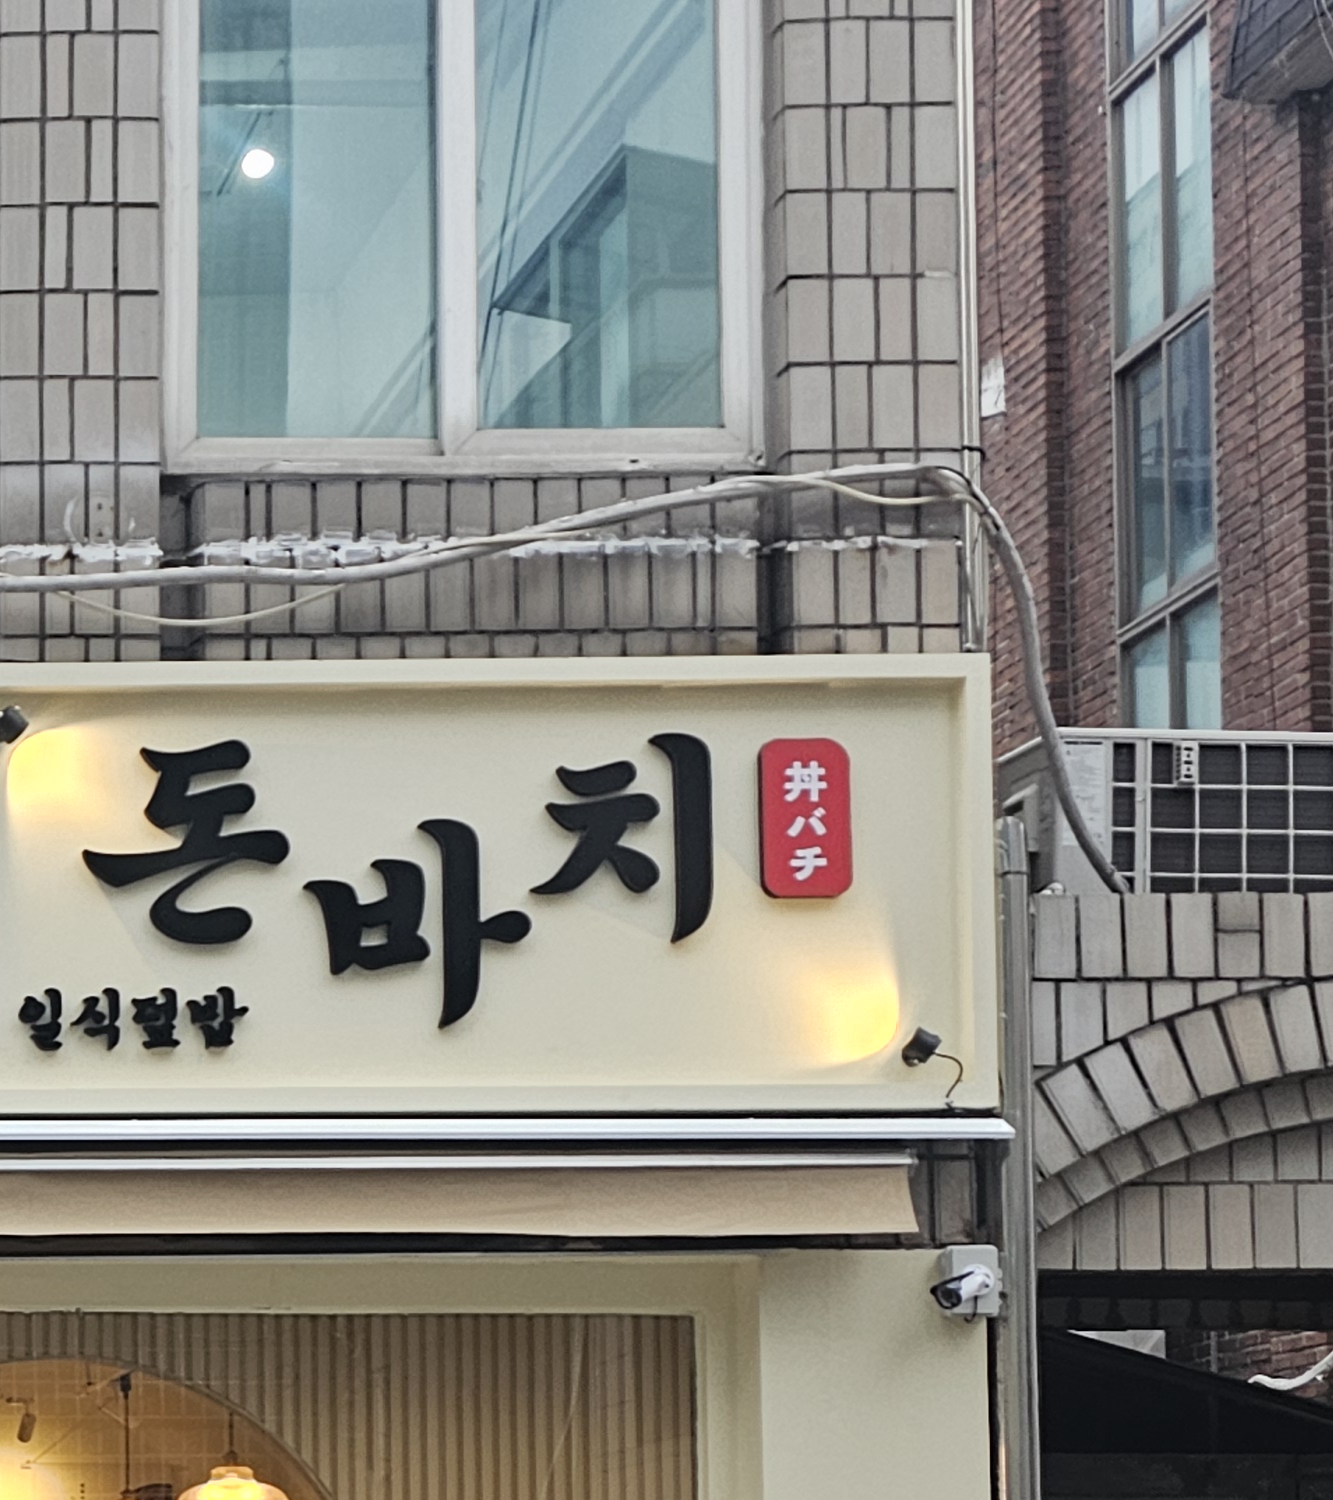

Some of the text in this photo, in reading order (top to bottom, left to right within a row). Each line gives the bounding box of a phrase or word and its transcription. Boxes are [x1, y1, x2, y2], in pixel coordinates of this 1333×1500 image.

[83, 732, 713, 1029] 돈바치
[783, 760, 828, 881] 丼バチ
[18, 987, 250, 1052] 일식덮밥
